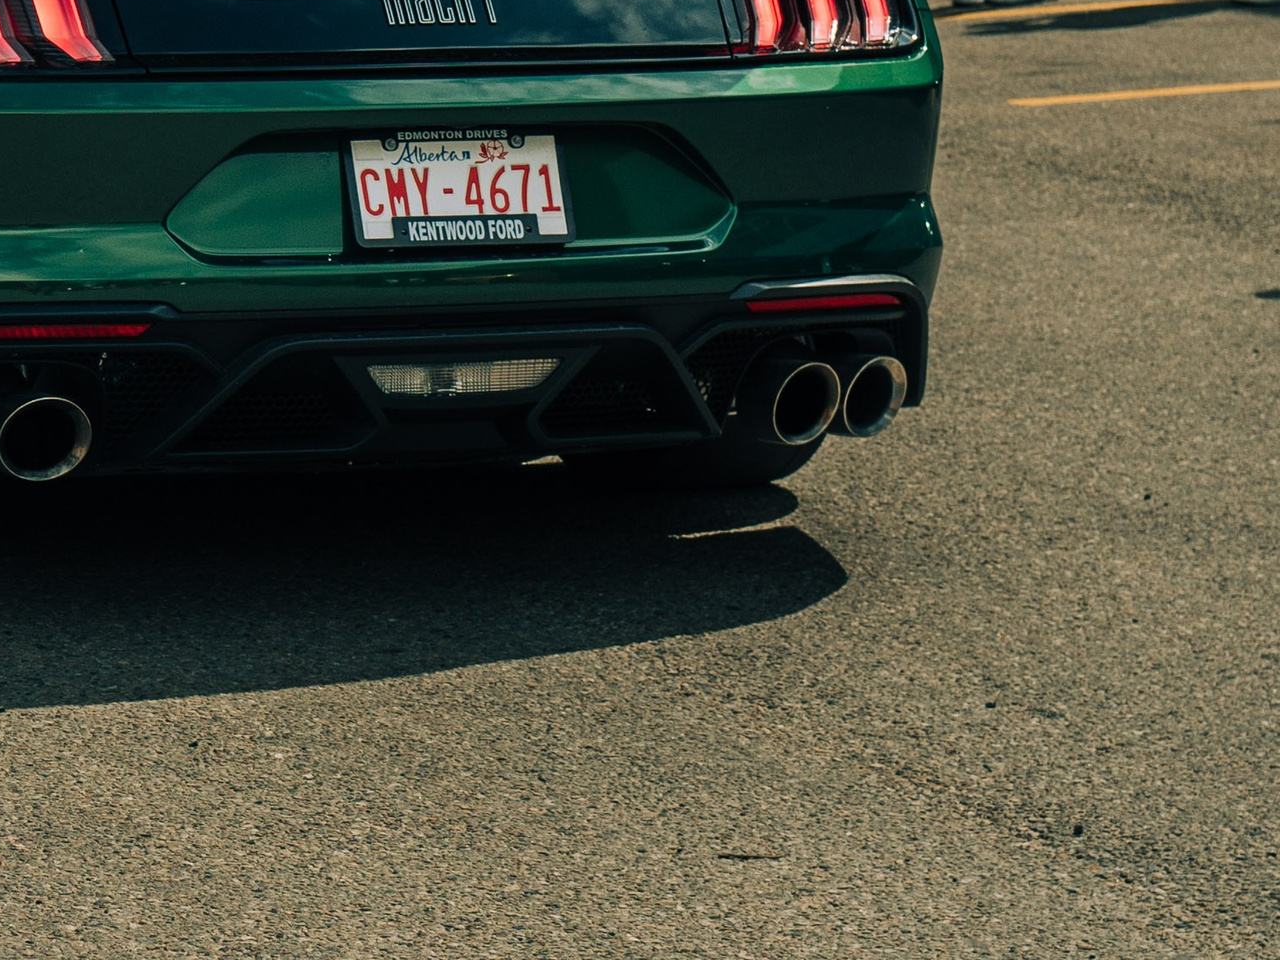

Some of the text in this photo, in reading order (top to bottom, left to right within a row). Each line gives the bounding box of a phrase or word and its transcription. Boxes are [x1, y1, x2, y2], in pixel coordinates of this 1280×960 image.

[397, 129, 508, 140] EDMONTON DRIVES
[391, 141, 464, 165] Alberta
[360, 164, 562, 217] CMY-4671
[408, 219, 525, 242] KENTWOOD FORD
